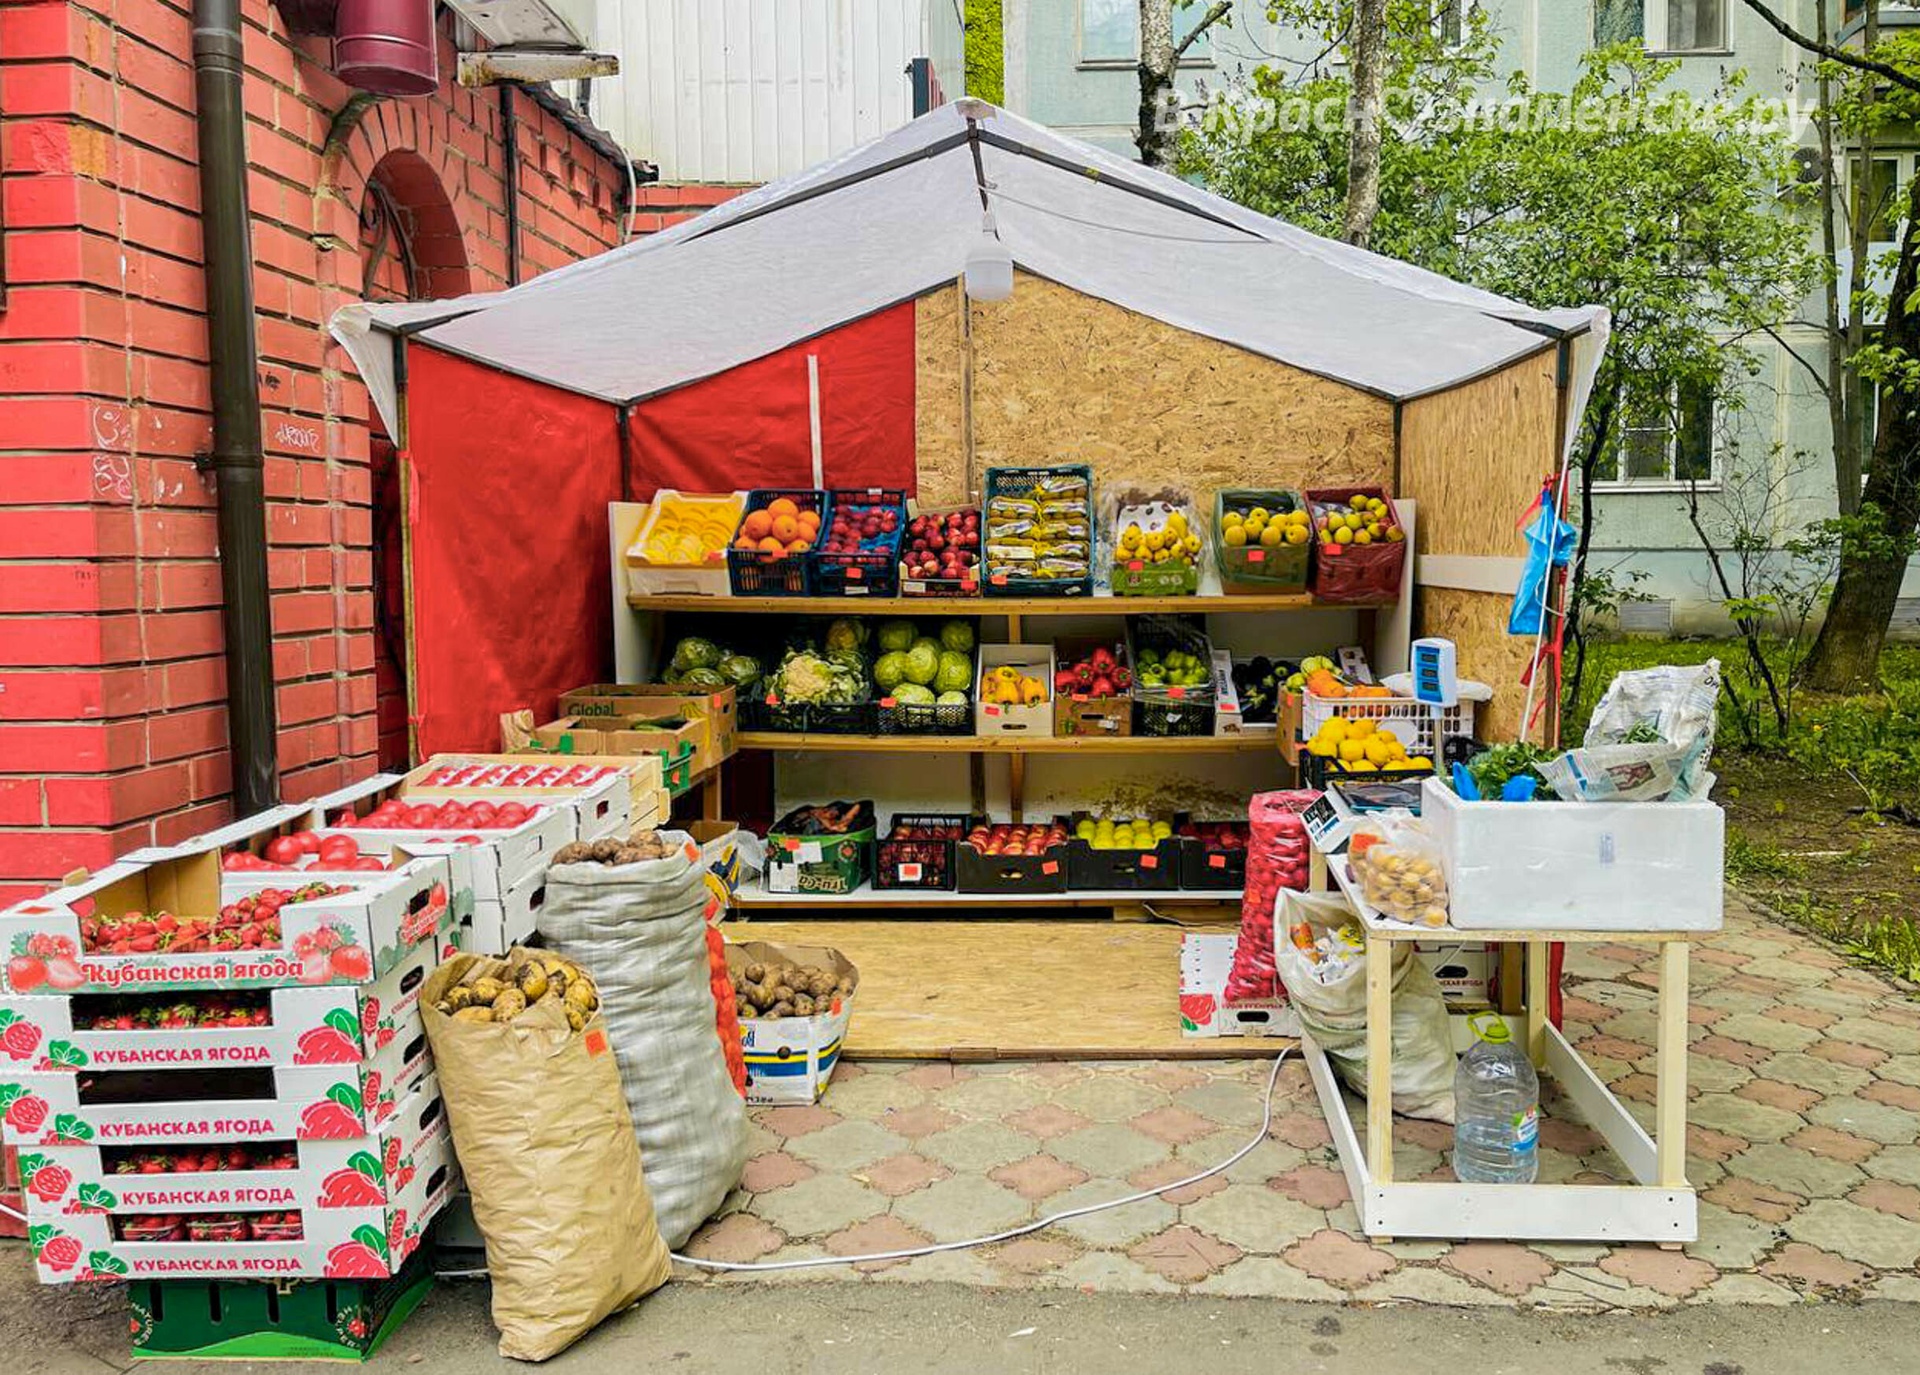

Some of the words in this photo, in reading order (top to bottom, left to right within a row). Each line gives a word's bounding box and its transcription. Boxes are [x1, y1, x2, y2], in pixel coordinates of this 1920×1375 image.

[81, 962, 227, 987] Кубанская
[232, 957, 304, 979] ягода
[93, 1048, 204, 1063] КУБАНСКАЯ
[207, 1045, 271, 1062] ЯГОДА
[99, 1120, 210, 1137] КУБАНСКАЯ
[213, 1118, 274, 1135] ЯГОДА
[122, 1189, 230, 1206] КУБАНСКАЯ
[234, 1187, 296, 1204] ЯГОДА
[133, 1258, 239, 1273] КУБАНСКАЯ
[241, 1256, 302, 1273] ЯГОДА
